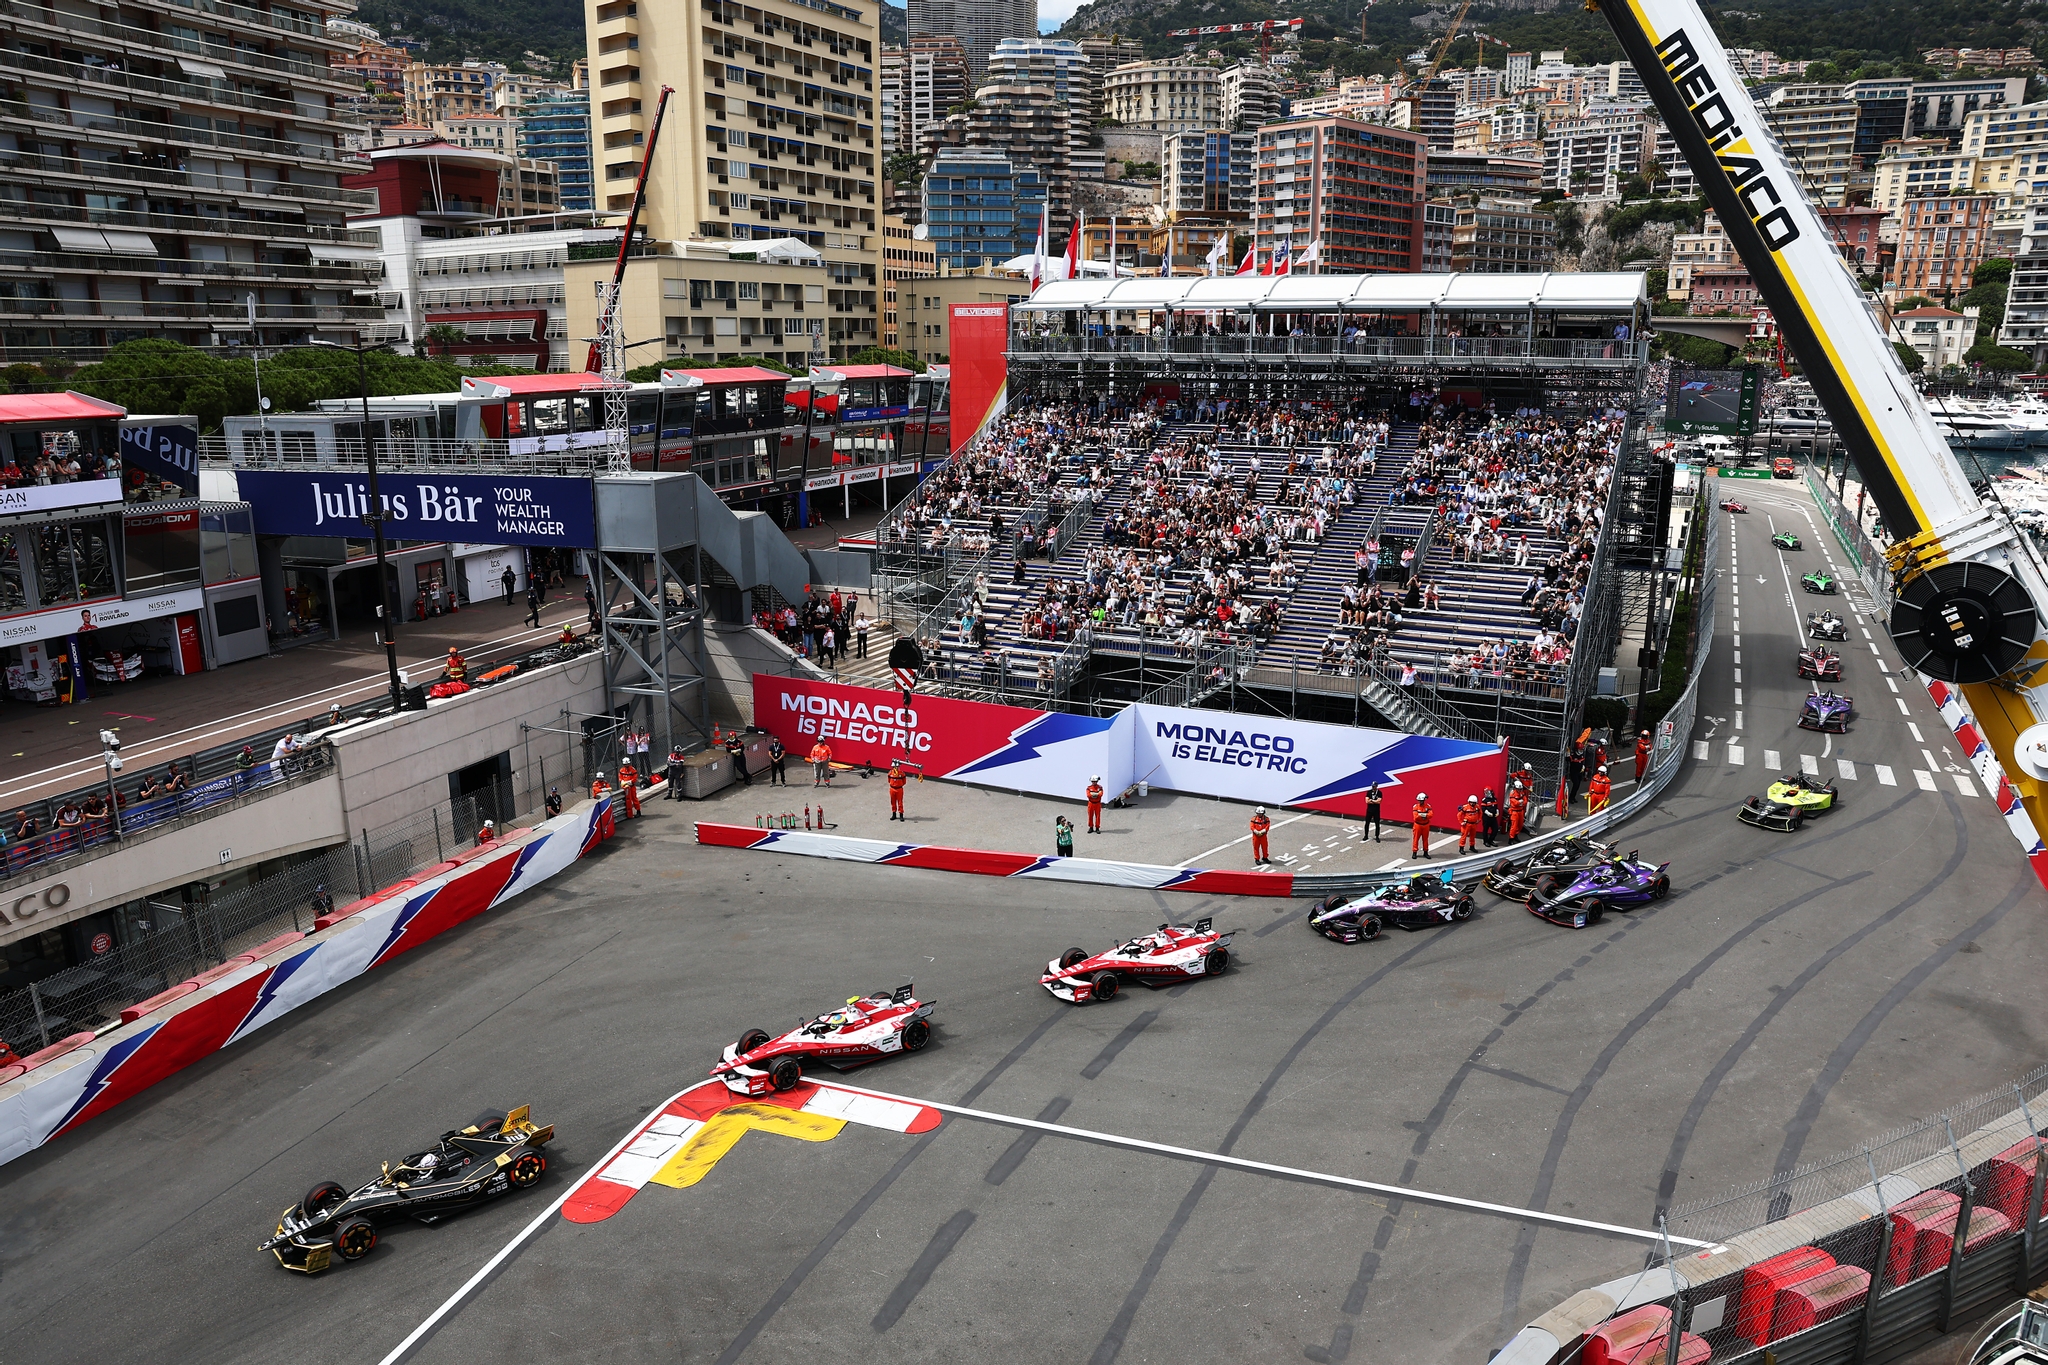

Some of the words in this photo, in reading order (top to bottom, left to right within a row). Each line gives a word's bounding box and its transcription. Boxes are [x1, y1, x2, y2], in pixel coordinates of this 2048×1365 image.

[954, 308, 1004, 316] BELVEDERE
[494, 488, 532, 502] YOUR
[416, 484, 483, 523] Bär
[495, 503, 551, 519] WEALTH
[498, 520, 565, 536] MANAGER
[148, 600, 176, 610] NISSAN
[100, 612, 130, 622] ROWLAND
[2, 624, 36, 636] NISSAN
[70, 642, 79, 664] BOOST
[780, 692, 918, 728] MONACO
[820, 718, 933, 752] ELECTRIC
[1156, 722, 1294, 754] MONACO
[1194, 744, 1308, 774] ELECTRIC
[820, 1046, 869, 1055] NISSAN
[413, 1182, 480, 1204] AUTOMOBILES
